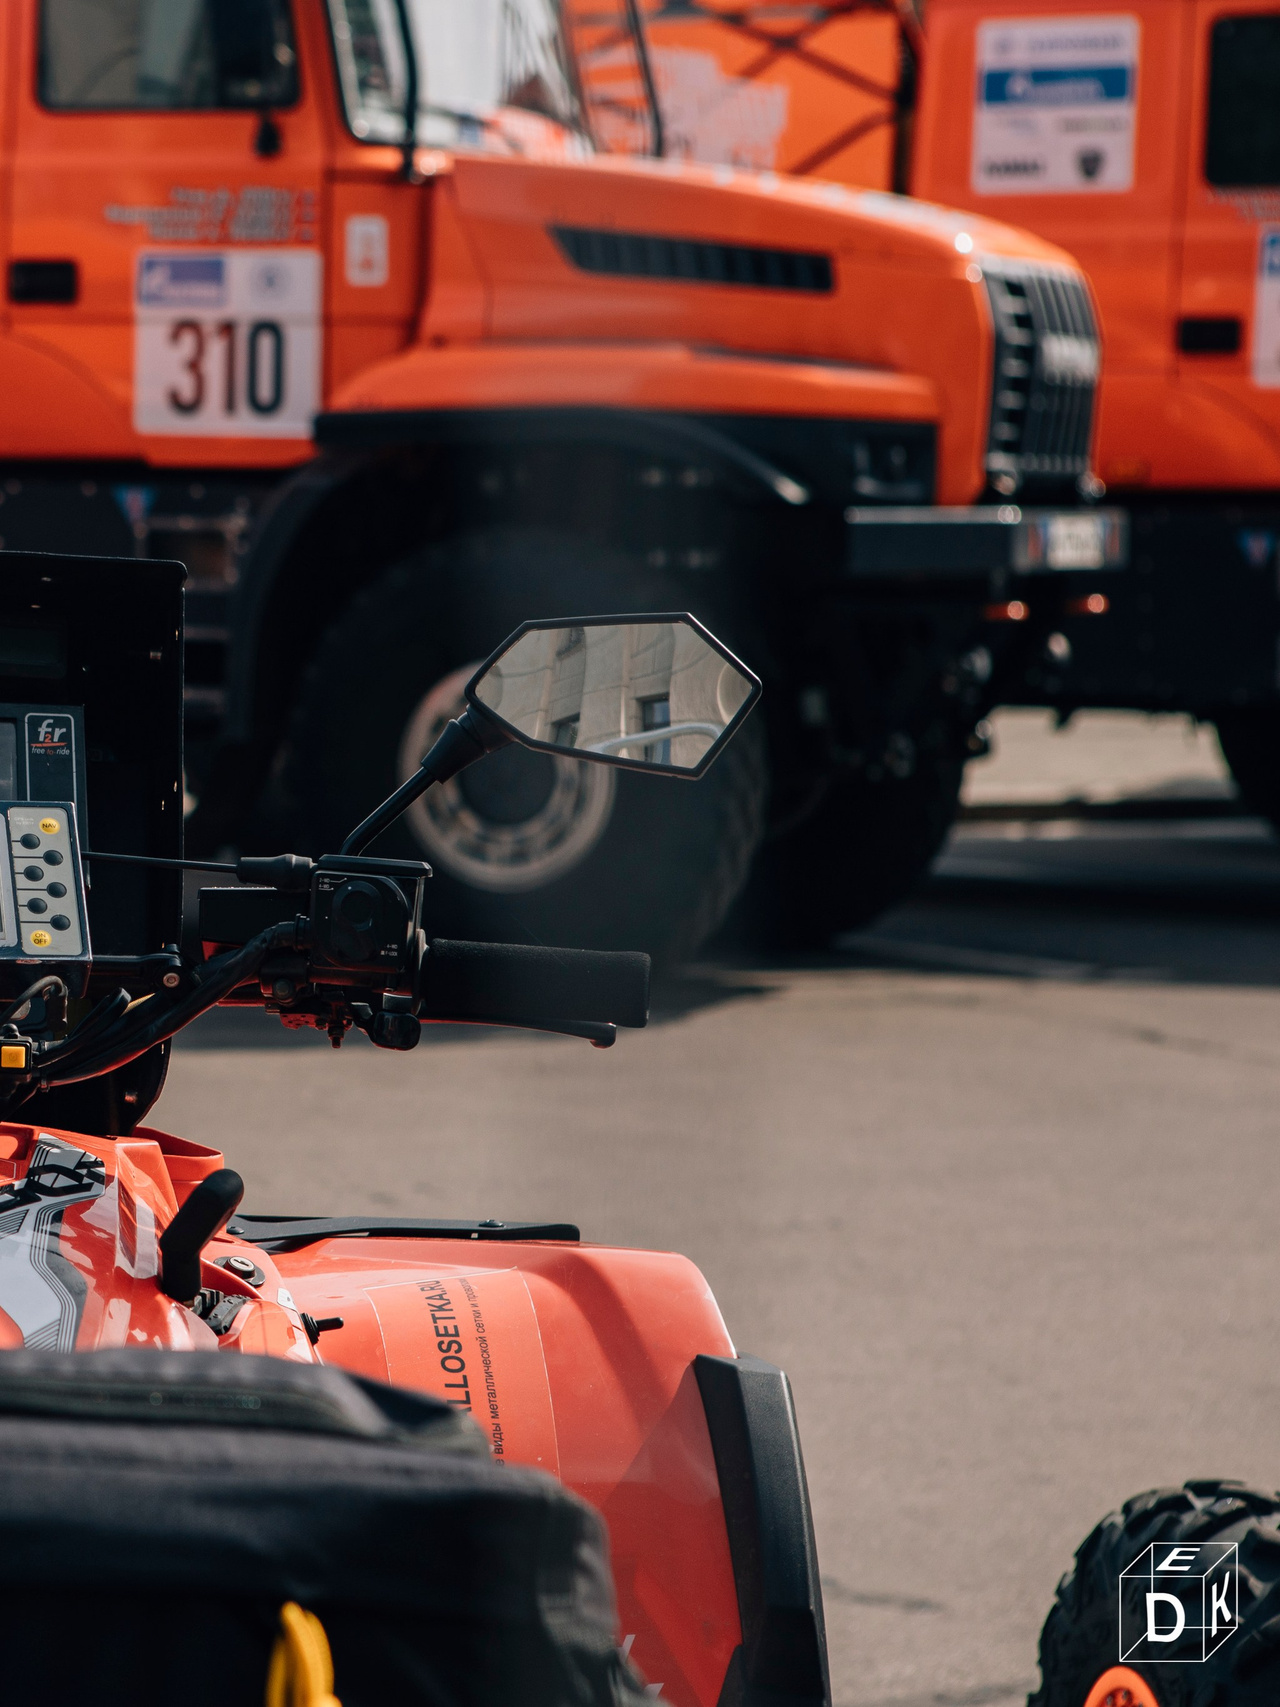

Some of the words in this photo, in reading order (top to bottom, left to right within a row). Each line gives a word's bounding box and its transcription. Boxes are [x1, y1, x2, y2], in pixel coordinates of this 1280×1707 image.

[168, 318, 284, 416] 310
[471, 1309, 485, 1333] сетки
[476, 1337, 500, 1419] металлической
[492, 1423, 505, 1454] виды
